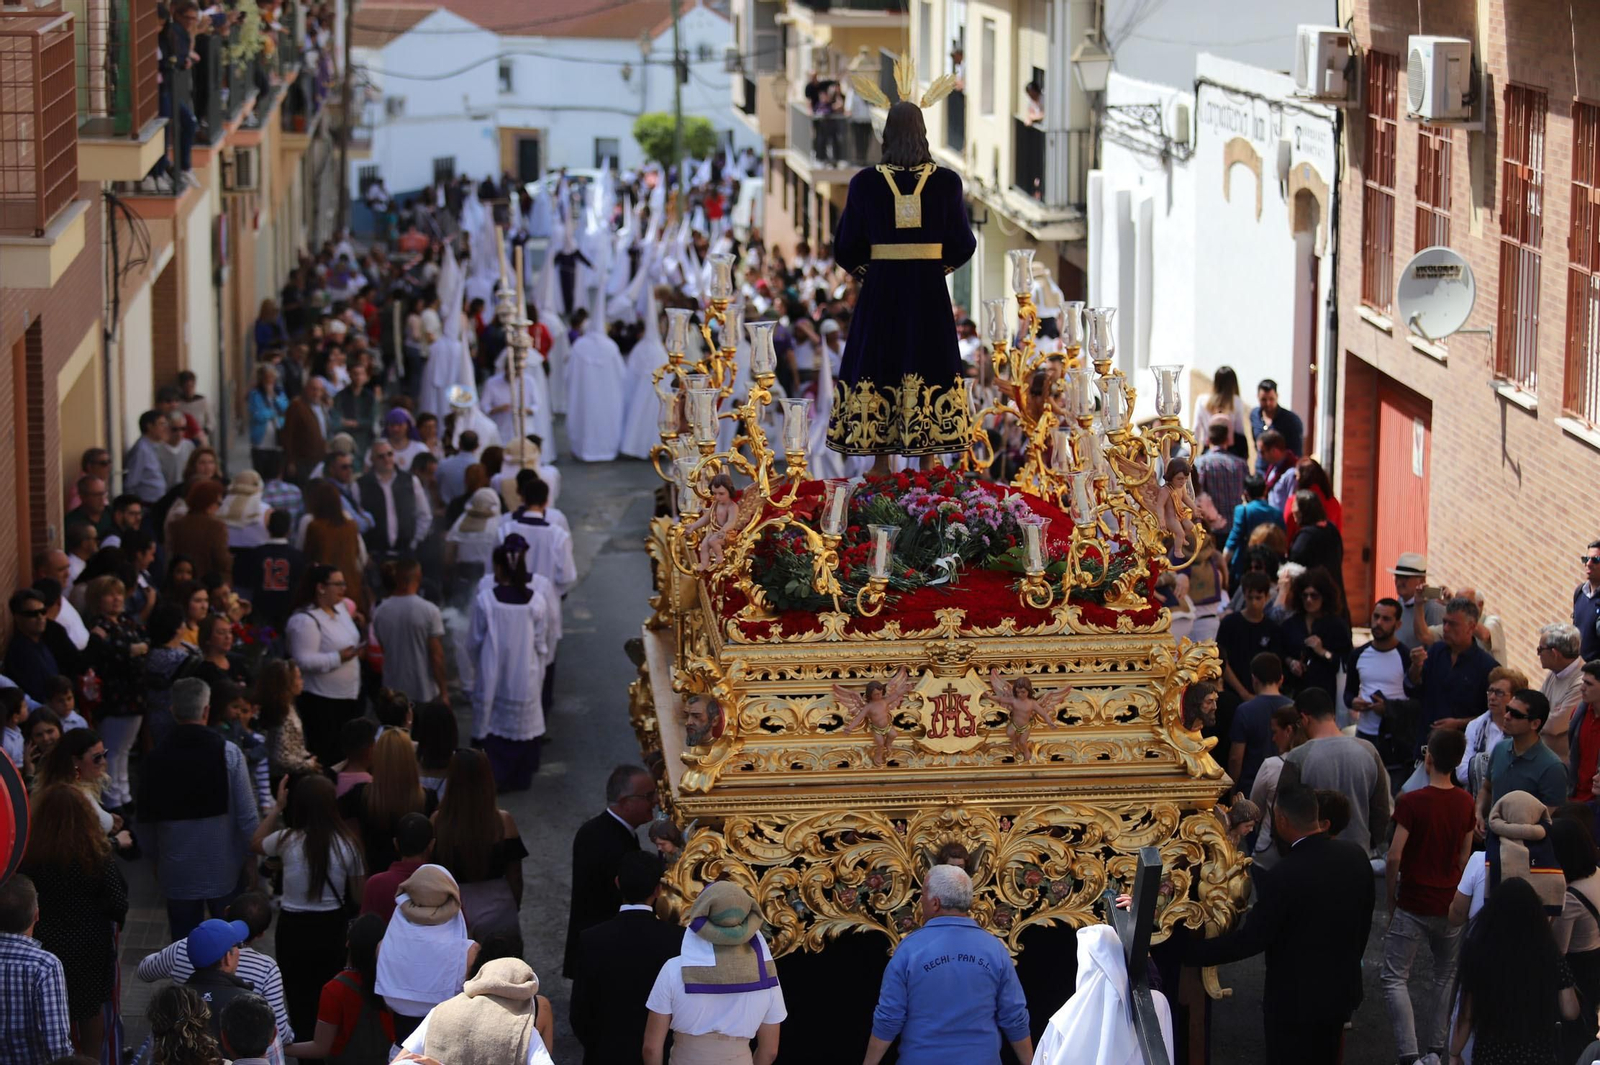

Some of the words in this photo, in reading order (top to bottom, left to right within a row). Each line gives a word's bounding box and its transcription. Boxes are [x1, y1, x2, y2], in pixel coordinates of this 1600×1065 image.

[263, 557, 290, 591] 12
[923, 955, 950, 972] RECHI
[957, 953, 976, 963] PAN
[978, 958, 991, 972] S.L.
